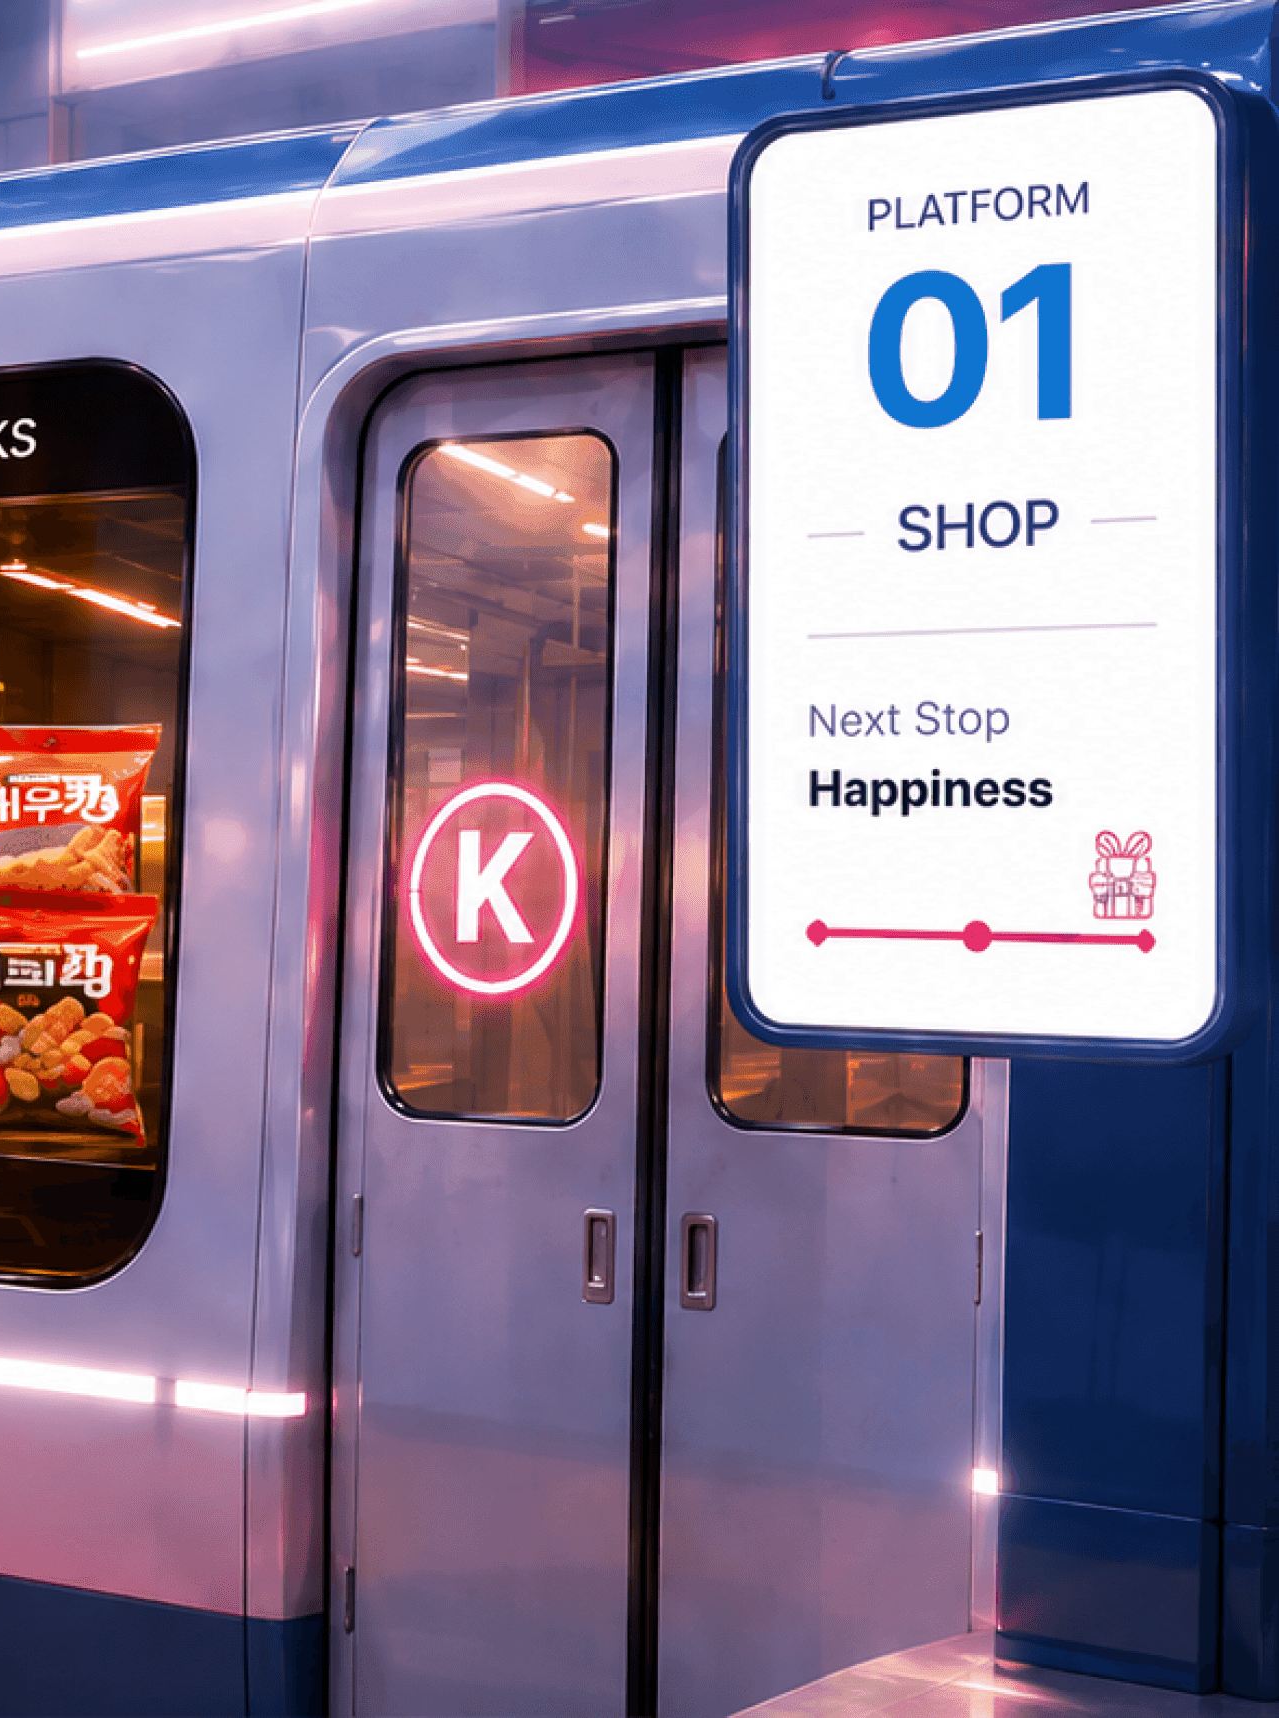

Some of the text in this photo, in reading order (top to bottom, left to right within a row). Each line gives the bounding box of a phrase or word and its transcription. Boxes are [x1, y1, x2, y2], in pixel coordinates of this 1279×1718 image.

[867, 181, 1090, 233] PLATFORM
[867, 261, 1073, 430] 01
[897, 498, 1060, 553] SHOP
[808, 699, 1011, 745] Next Stop
[808, 768, 1054, 818] Happiness
[456, 829, 534, 944] K
